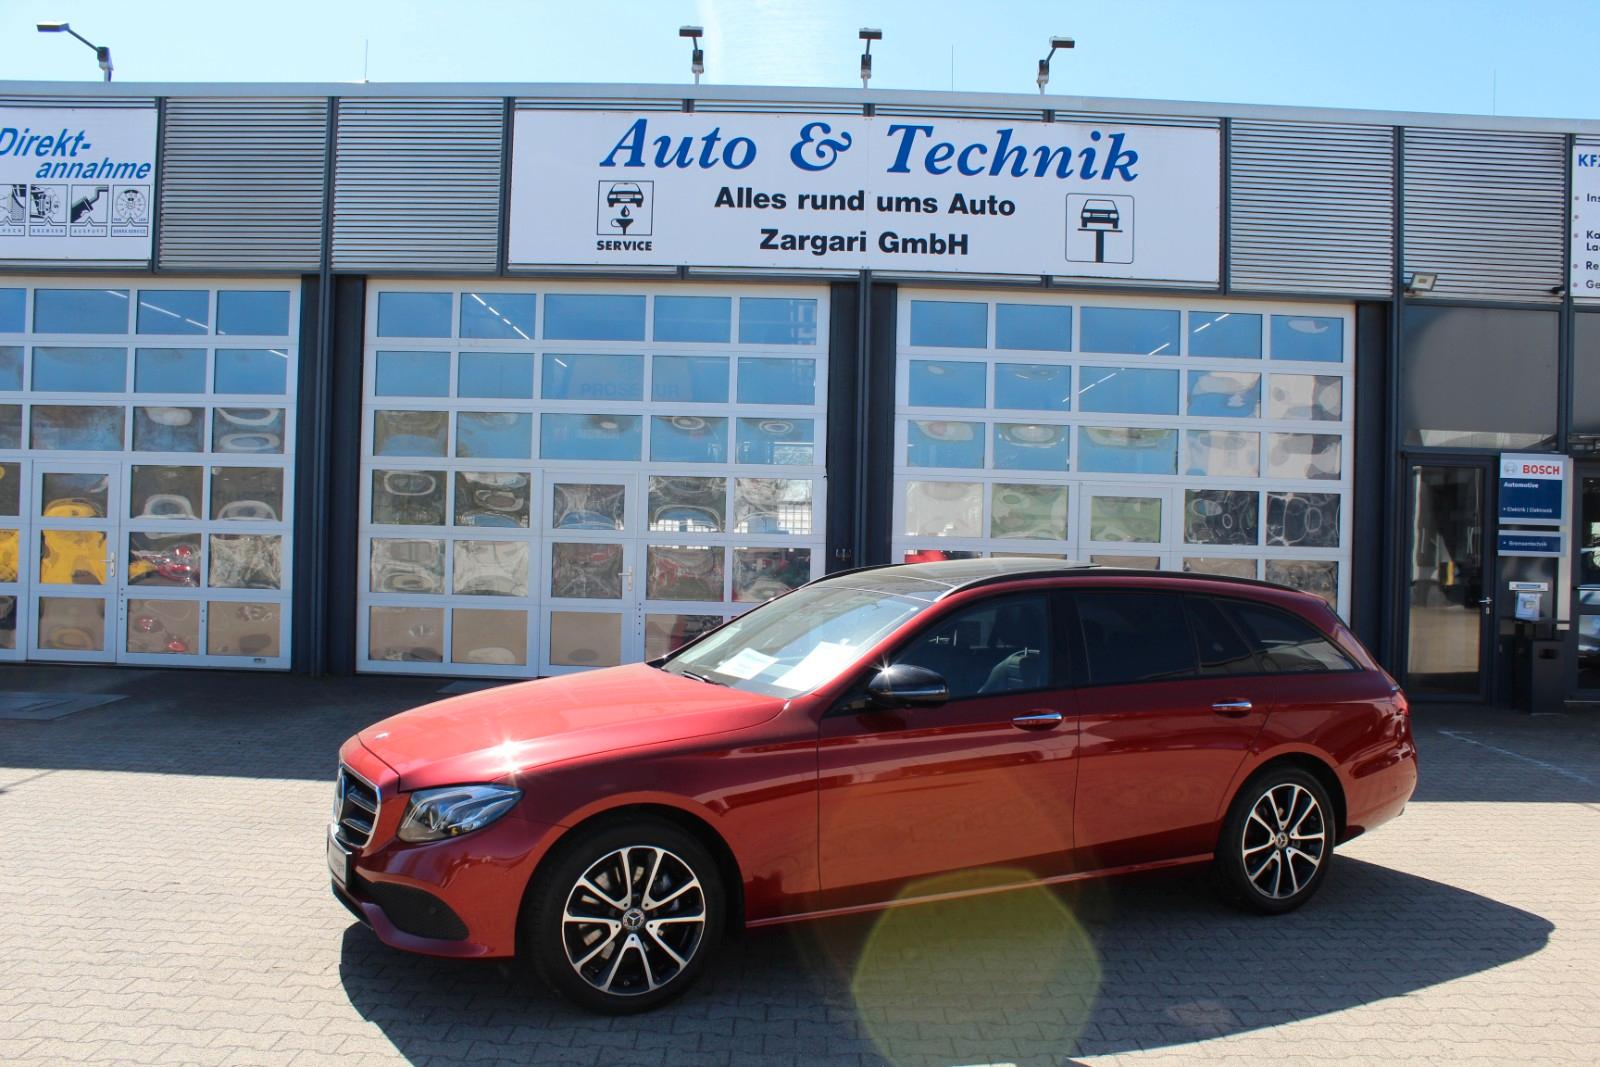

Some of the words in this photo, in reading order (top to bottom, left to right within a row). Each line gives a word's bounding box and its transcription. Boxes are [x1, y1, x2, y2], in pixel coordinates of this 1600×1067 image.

[0, 128, 91, 157] Direkt-
[599, 118, 757, 170] Auto
[790, 121, 852, 172] &
[886, 124, 1139, 182] Technik
[35, 157, 151, 179] annahme
[714, 186, 787, 210] Alles
[797, 189, 865, 212] rund
[876, 195, 939, 214] ums
[947, 192, 1016, 216] Auto
[596, 240, 652, 252] SERVICE
[759, 228, 866, 256] Zargari
[878, 231, 969, 255] GmbH
[1522, 464, 1560, 475] BOSCH
